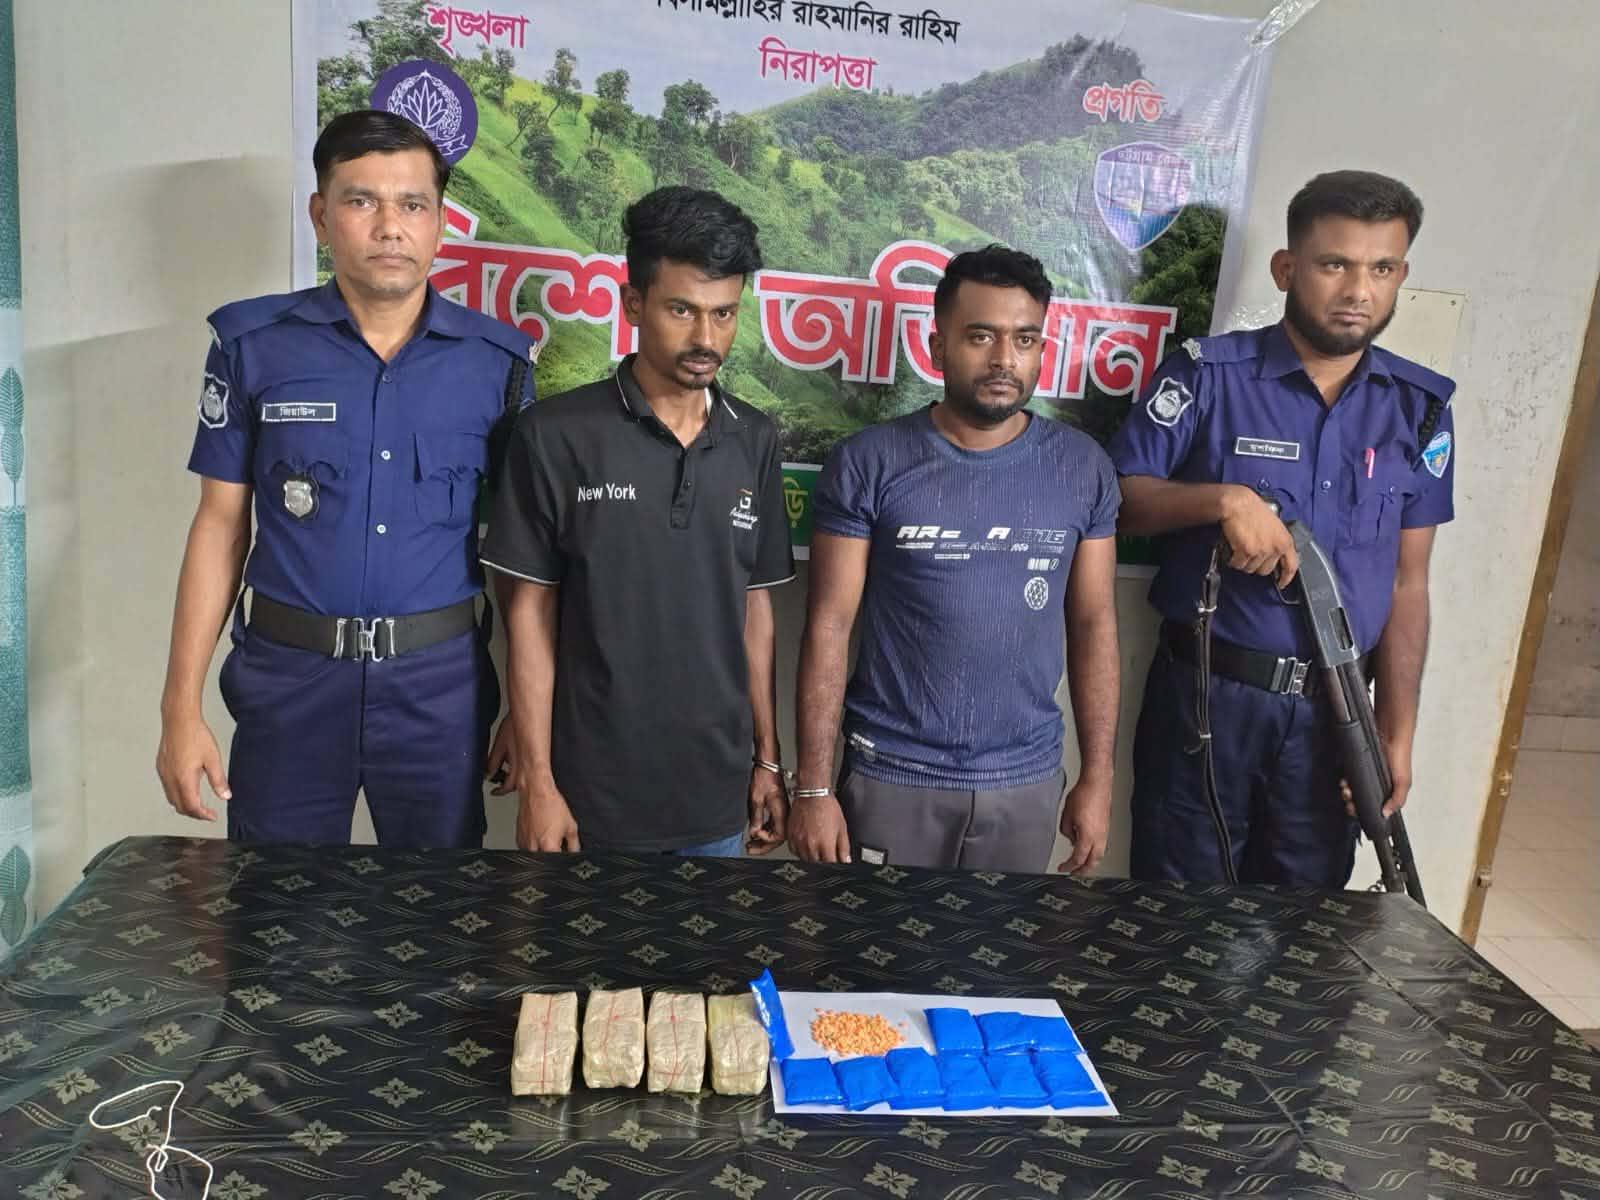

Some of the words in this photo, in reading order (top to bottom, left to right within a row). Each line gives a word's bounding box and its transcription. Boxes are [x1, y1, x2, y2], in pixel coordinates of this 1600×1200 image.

[425, 5, 531, 57] শৃঙ্খলা
[793, 0, 892, 34] রাহমানির
[899, 9, 961, 43] রাহিম
[758, 35, 878, 90] নিরাপত্তা
[1083, 79, 1164, 123] প্রগতি
[577, 485, 603, 502] New
[605, 482, 637, 500] York
